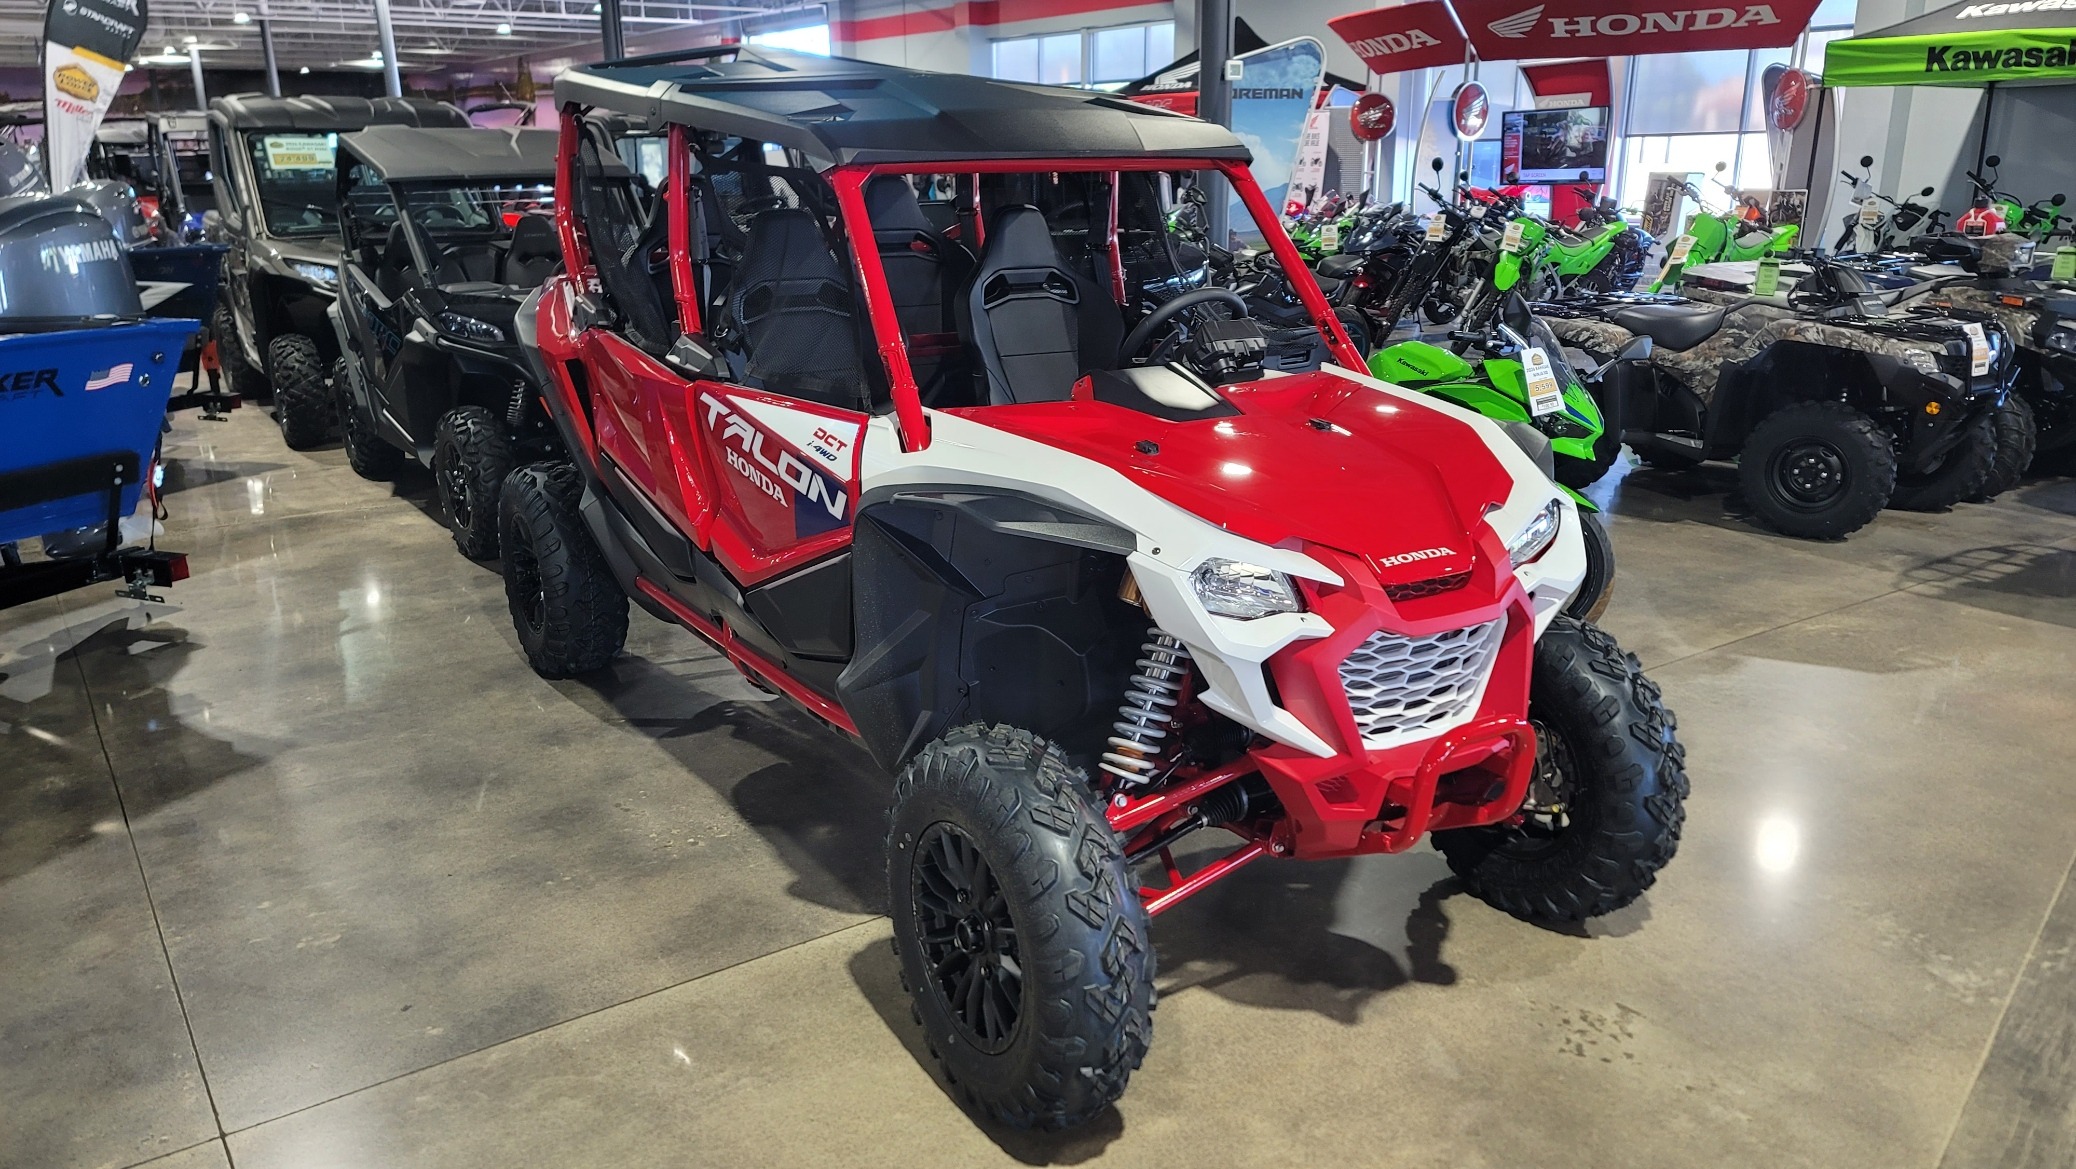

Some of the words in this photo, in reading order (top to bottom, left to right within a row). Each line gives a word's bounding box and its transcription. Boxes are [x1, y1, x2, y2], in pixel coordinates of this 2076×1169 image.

[1548, 4, 1781, 38] HONDA
[1140, 81, 1193, 92] HONDA
[1548, 98, 1585, 108] HONDA
[58, 239, 119, 266] YAMAHA
[1396, 357, 1430, 377] Kawasaki
[1535, 382, 1553, 392] 5,599
[813, 427, 848, 452] DCT
[699, 391, 848, 521] TALON
[726, 446, 789, 508] HONDA
[1379, 547, 1457, 567] HONDA
